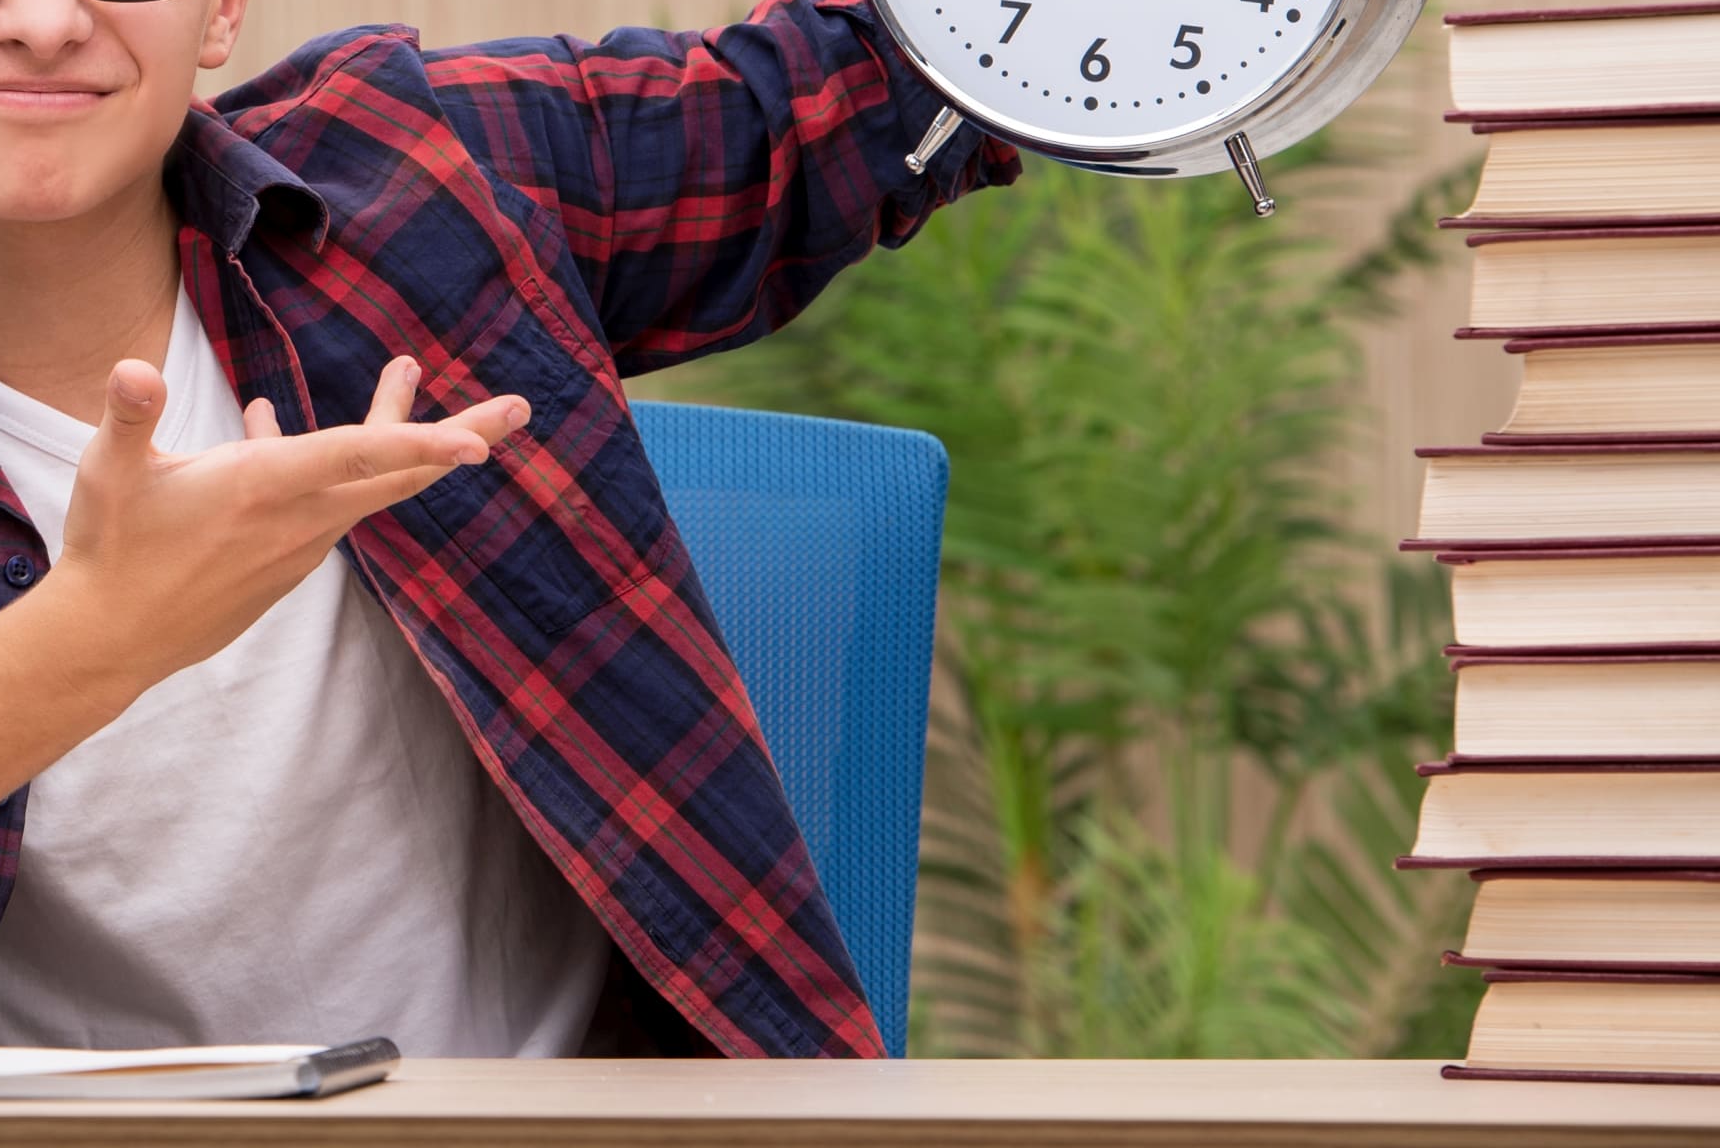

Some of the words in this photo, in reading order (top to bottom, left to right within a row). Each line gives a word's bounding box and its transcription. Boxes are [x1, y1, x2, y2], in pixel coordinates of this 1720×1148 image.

[998, 0, 1033, 44] 7
[1079, 37, 1112, 83] 6
[1168, 24, 1205, 70] 5
